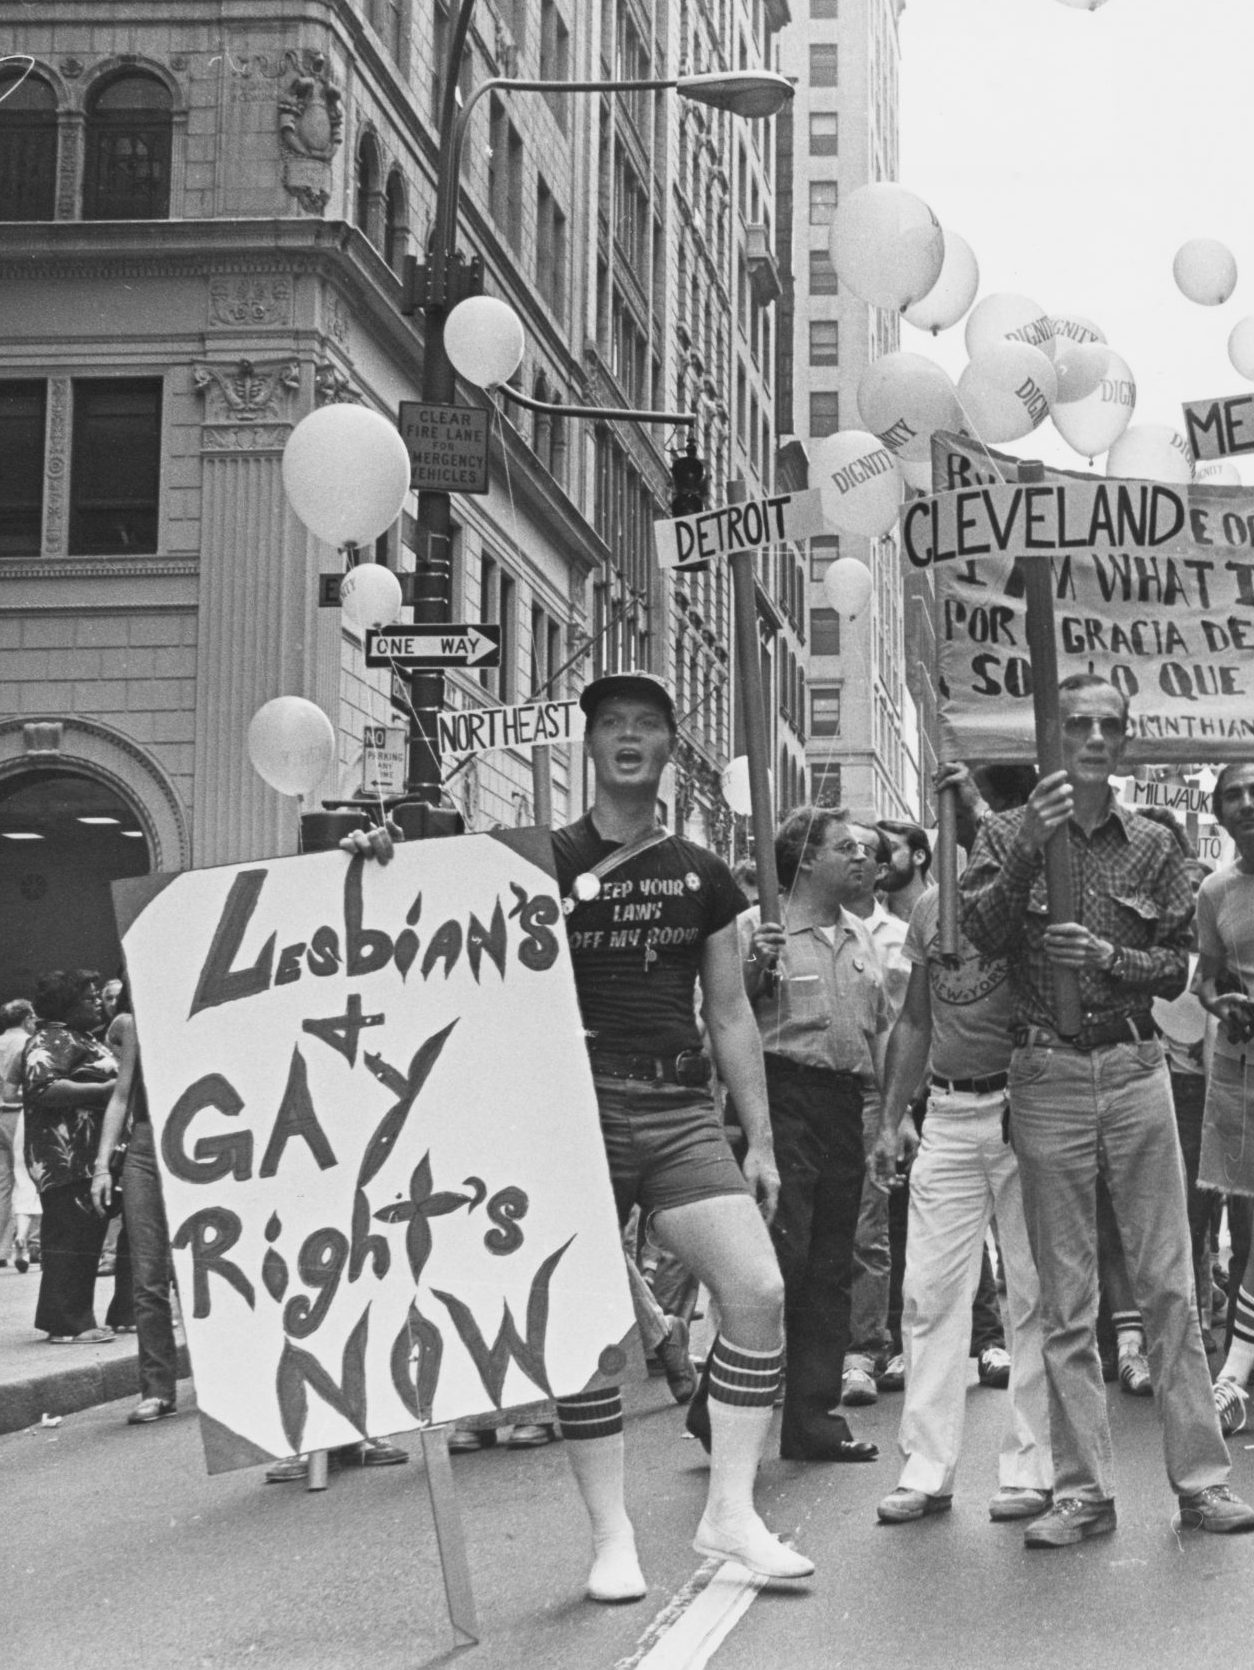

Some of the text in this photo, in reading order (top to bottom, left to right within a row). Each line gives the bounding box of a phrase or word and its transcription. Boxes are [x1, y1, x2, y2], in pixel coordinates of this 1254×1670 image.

[420, 411, 471, 425] CLEAR
[407, 424, 483, 442] FIRE LANE
[432, 441, 454, 451] FOR
[411, 450, 483, 469] MERGENCY
[831, 449, 896, 495] DIGNITY
[675, 496, 791, 562] DETROIT
[904, 484, 1185, 567] CLEVELAND
[1094, 553, 1214, 608] WHAT
[945, 600, 1017, 645] POR
[1062, 615, 1189, 655] GRACIA
[377, 638, 480, 654] ONE WAY
[972, 653, 1034, 698] SO
[1159, 661, 1245, 700] QUE
[366, 731, 384, 745] NO
[440, 701, 578, 753] NORTHEAST
[368, 752, 403, 762] PARKING
[597, 878, 685, 900] EEP YOUR
[613, 901, 663, 922] LAWS
[569, 931, 605, 949] OFF
[609, 928, 642, 948] MY
[161, 1016, 460, 1190] GAY
[276, 1233, 578, 1454] NOW
